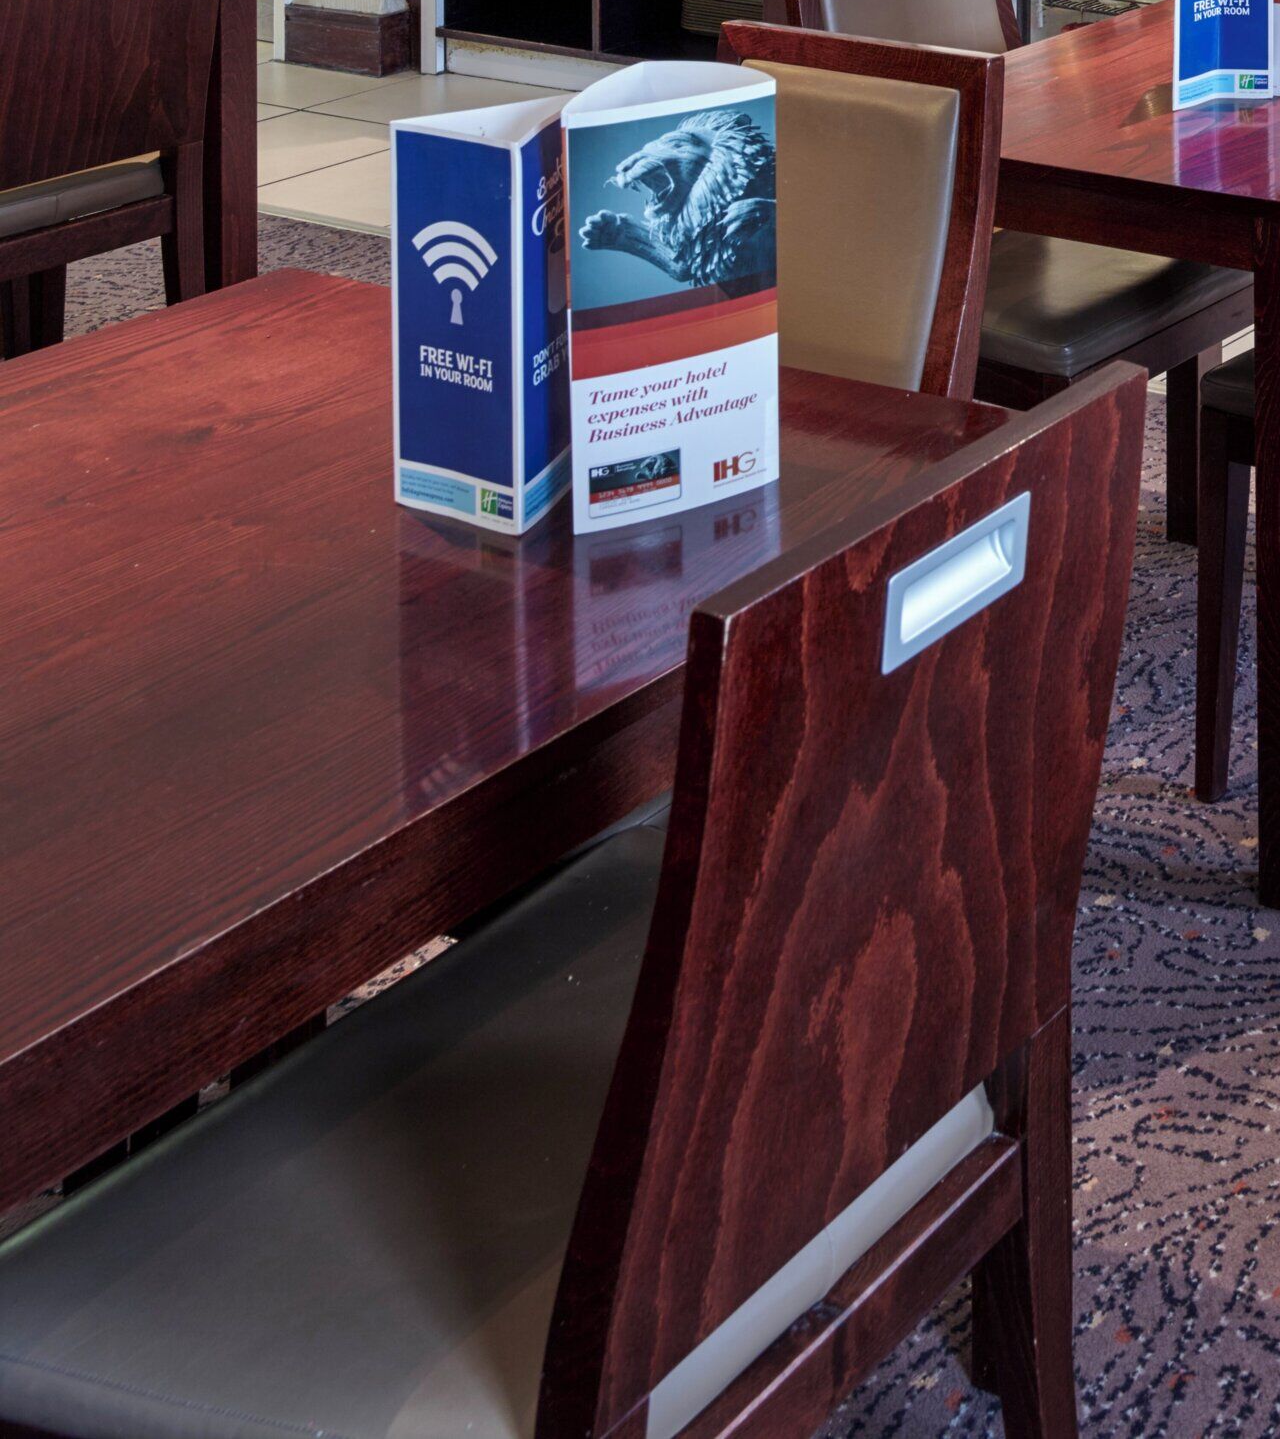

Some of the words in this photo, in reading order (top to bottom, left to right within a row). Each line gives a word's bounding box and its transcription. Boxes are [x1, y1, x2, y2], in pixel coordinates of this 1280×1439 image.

[1194, 12, 1202, 22] IN
[1203, 7, 1222, 19] YOUR
[1224, 7, 1250, 16] ROOM
[420, 345, 454, 368] FREE
[456, 352, 493, 378] WI-FI
[420, 363, 432, 378] IN
[434, 366, 462, 384] YOUR
[463, 373, 493, 393] ROOM
[533, 353, 560, 386] GRAB
[590, 386, 639, 406] Tame
[640, 377, 683, 400] your
[686, 362, 728, 385] hotel
[587, 400, 667, 424] expenses
[671, 386, 709, 408] with
[588, 418, 667, 444] Business
[670, 392, 758, 426] Advantage
[591, 467, 609, 478] IHG
[713, 451, 756, 482] IHG
